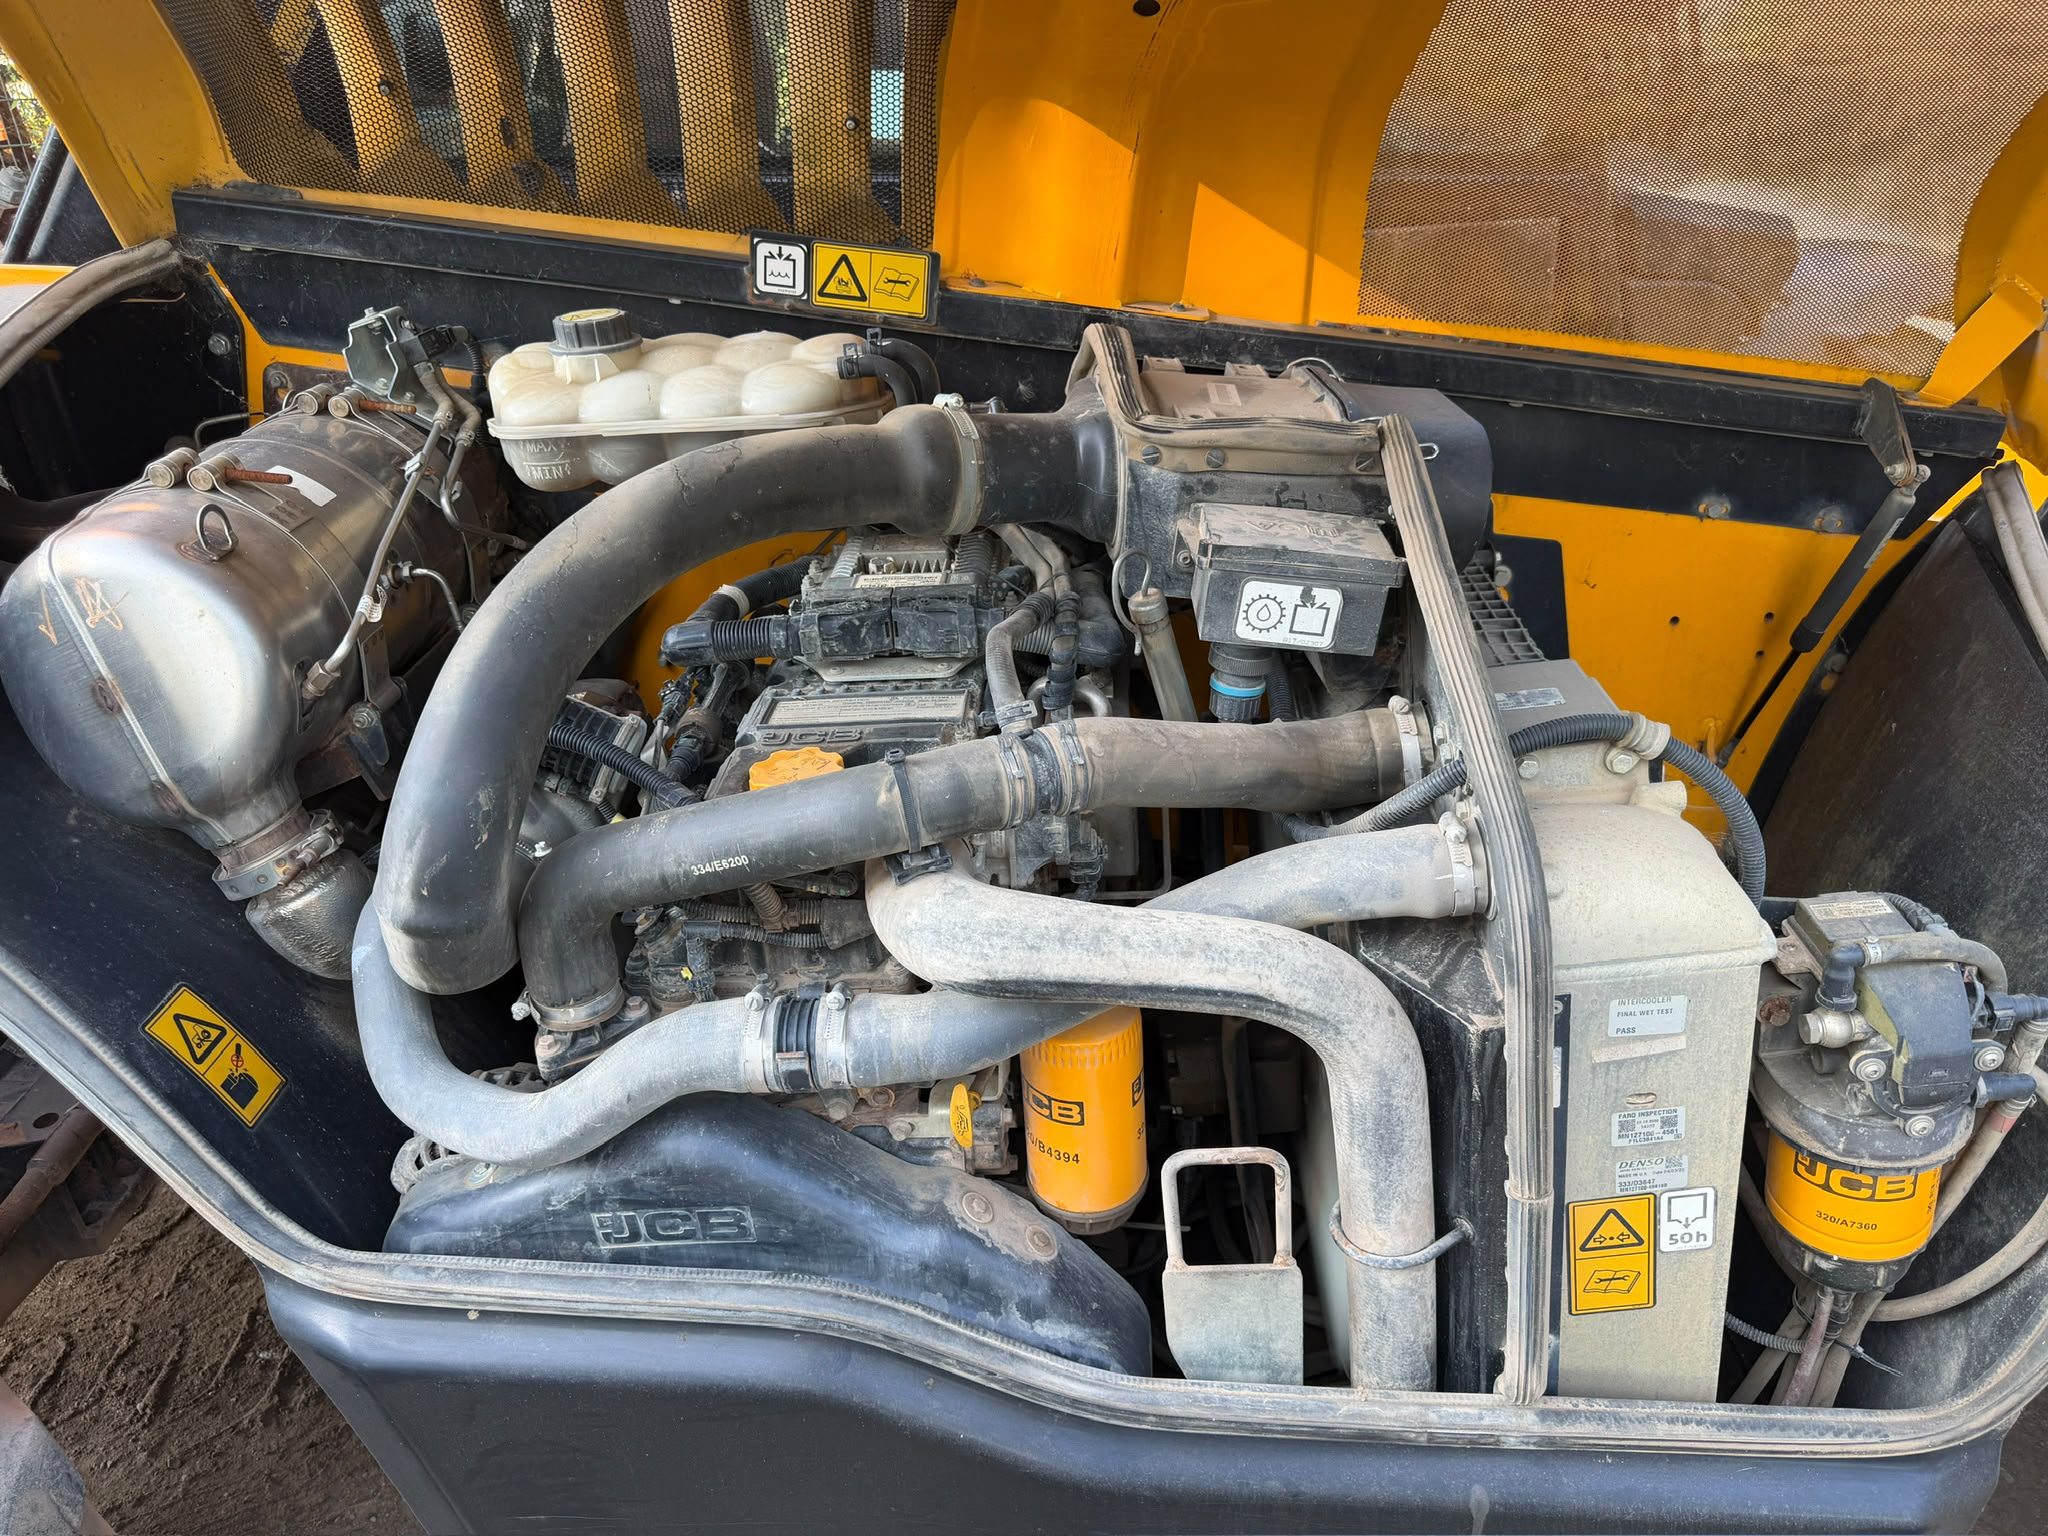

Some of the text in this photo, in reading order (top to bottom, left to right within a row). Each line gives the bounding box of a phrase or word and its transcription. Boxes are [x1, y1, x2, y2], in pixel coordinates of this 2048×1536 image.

[530, 465, 564, 480] MIN
[761, 729, 863, 746] JCB
[690, 855, 749, 876] 334/E6200
[1617, 996, 1672, 1007] INTERCOOLER
[1616, 1010, 1637, 1018] FINAL
[1615, 1026, 1636, 1035] PASS
[1638, 1108, 1678, 1118] INSPECTION
[1619, 1157, 1665, 1169] DENSO
[1794, 1152, 1918, 1202] JCB
[592, 1206, 757, 1249] JCB
[1815, 1209, 1879, 1231] 320/A7360
